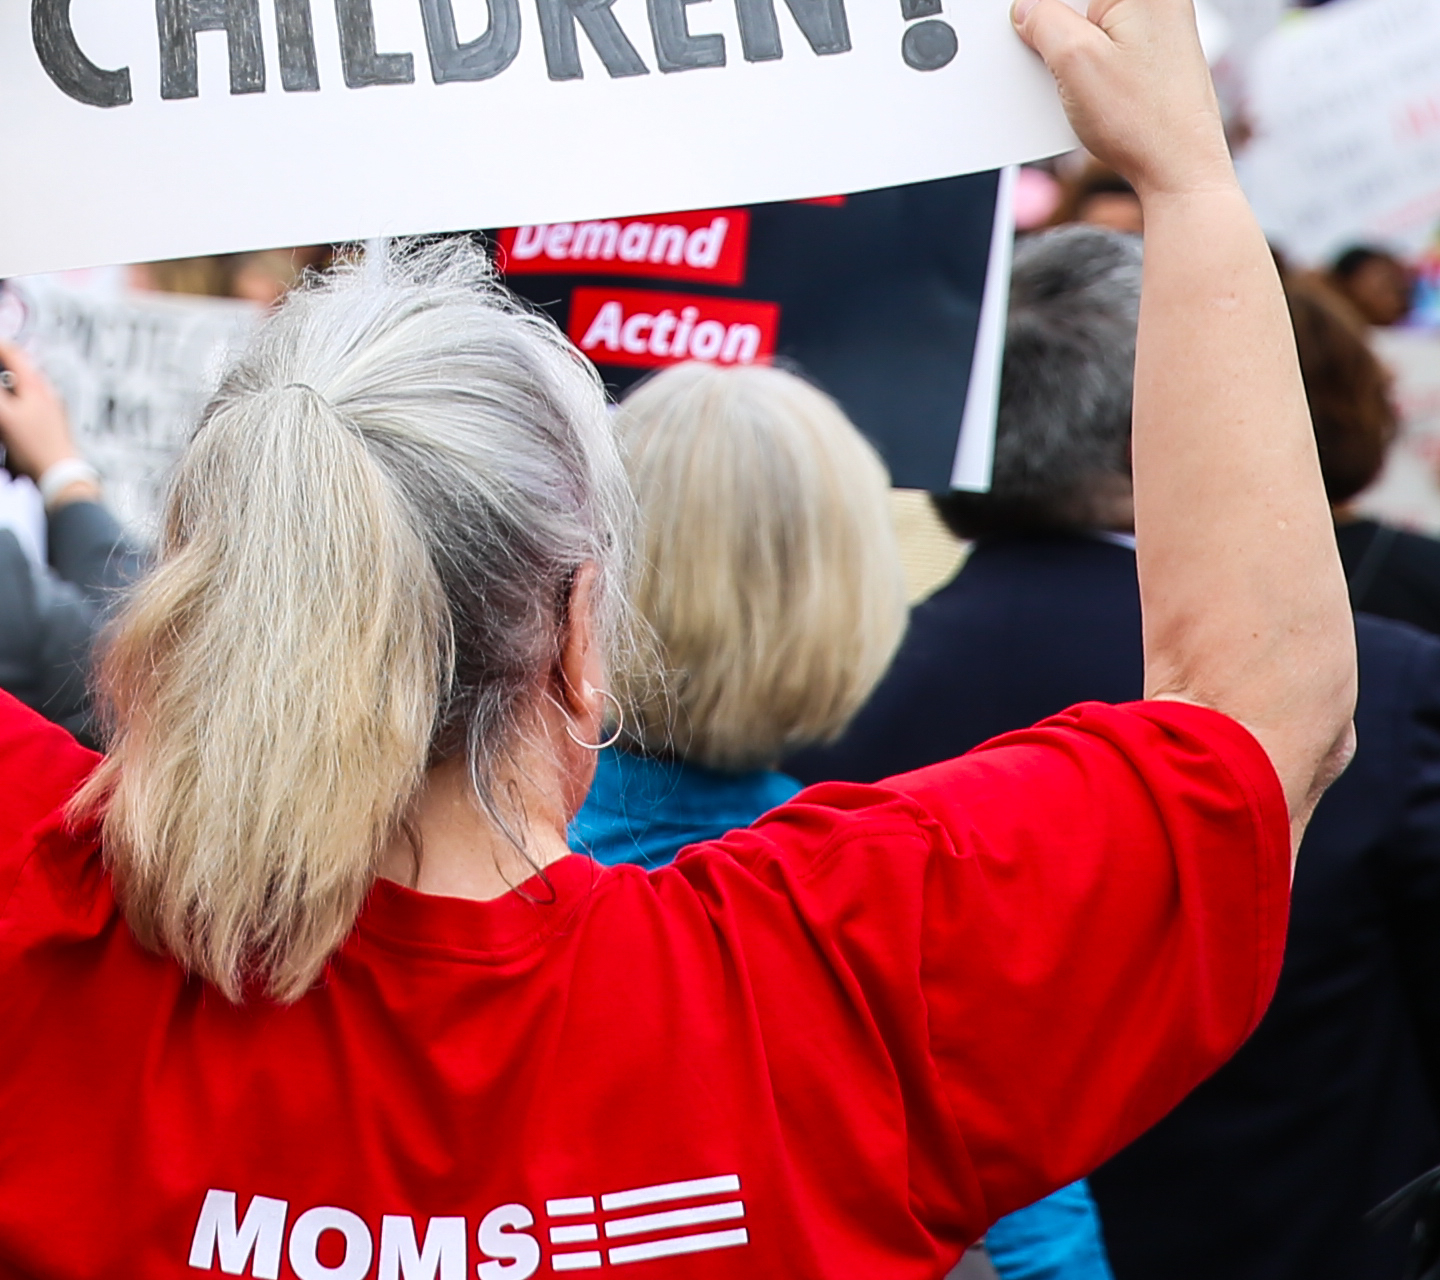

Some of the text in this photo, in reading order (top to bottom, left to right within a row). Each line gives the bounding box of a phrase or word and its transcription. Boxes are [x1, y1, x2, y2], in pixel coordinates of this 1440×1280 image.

[511, 216, 729, 269] Demand
[579, 301, 762, 362] Action
[188, 1188, 541, 1280] MOMS
